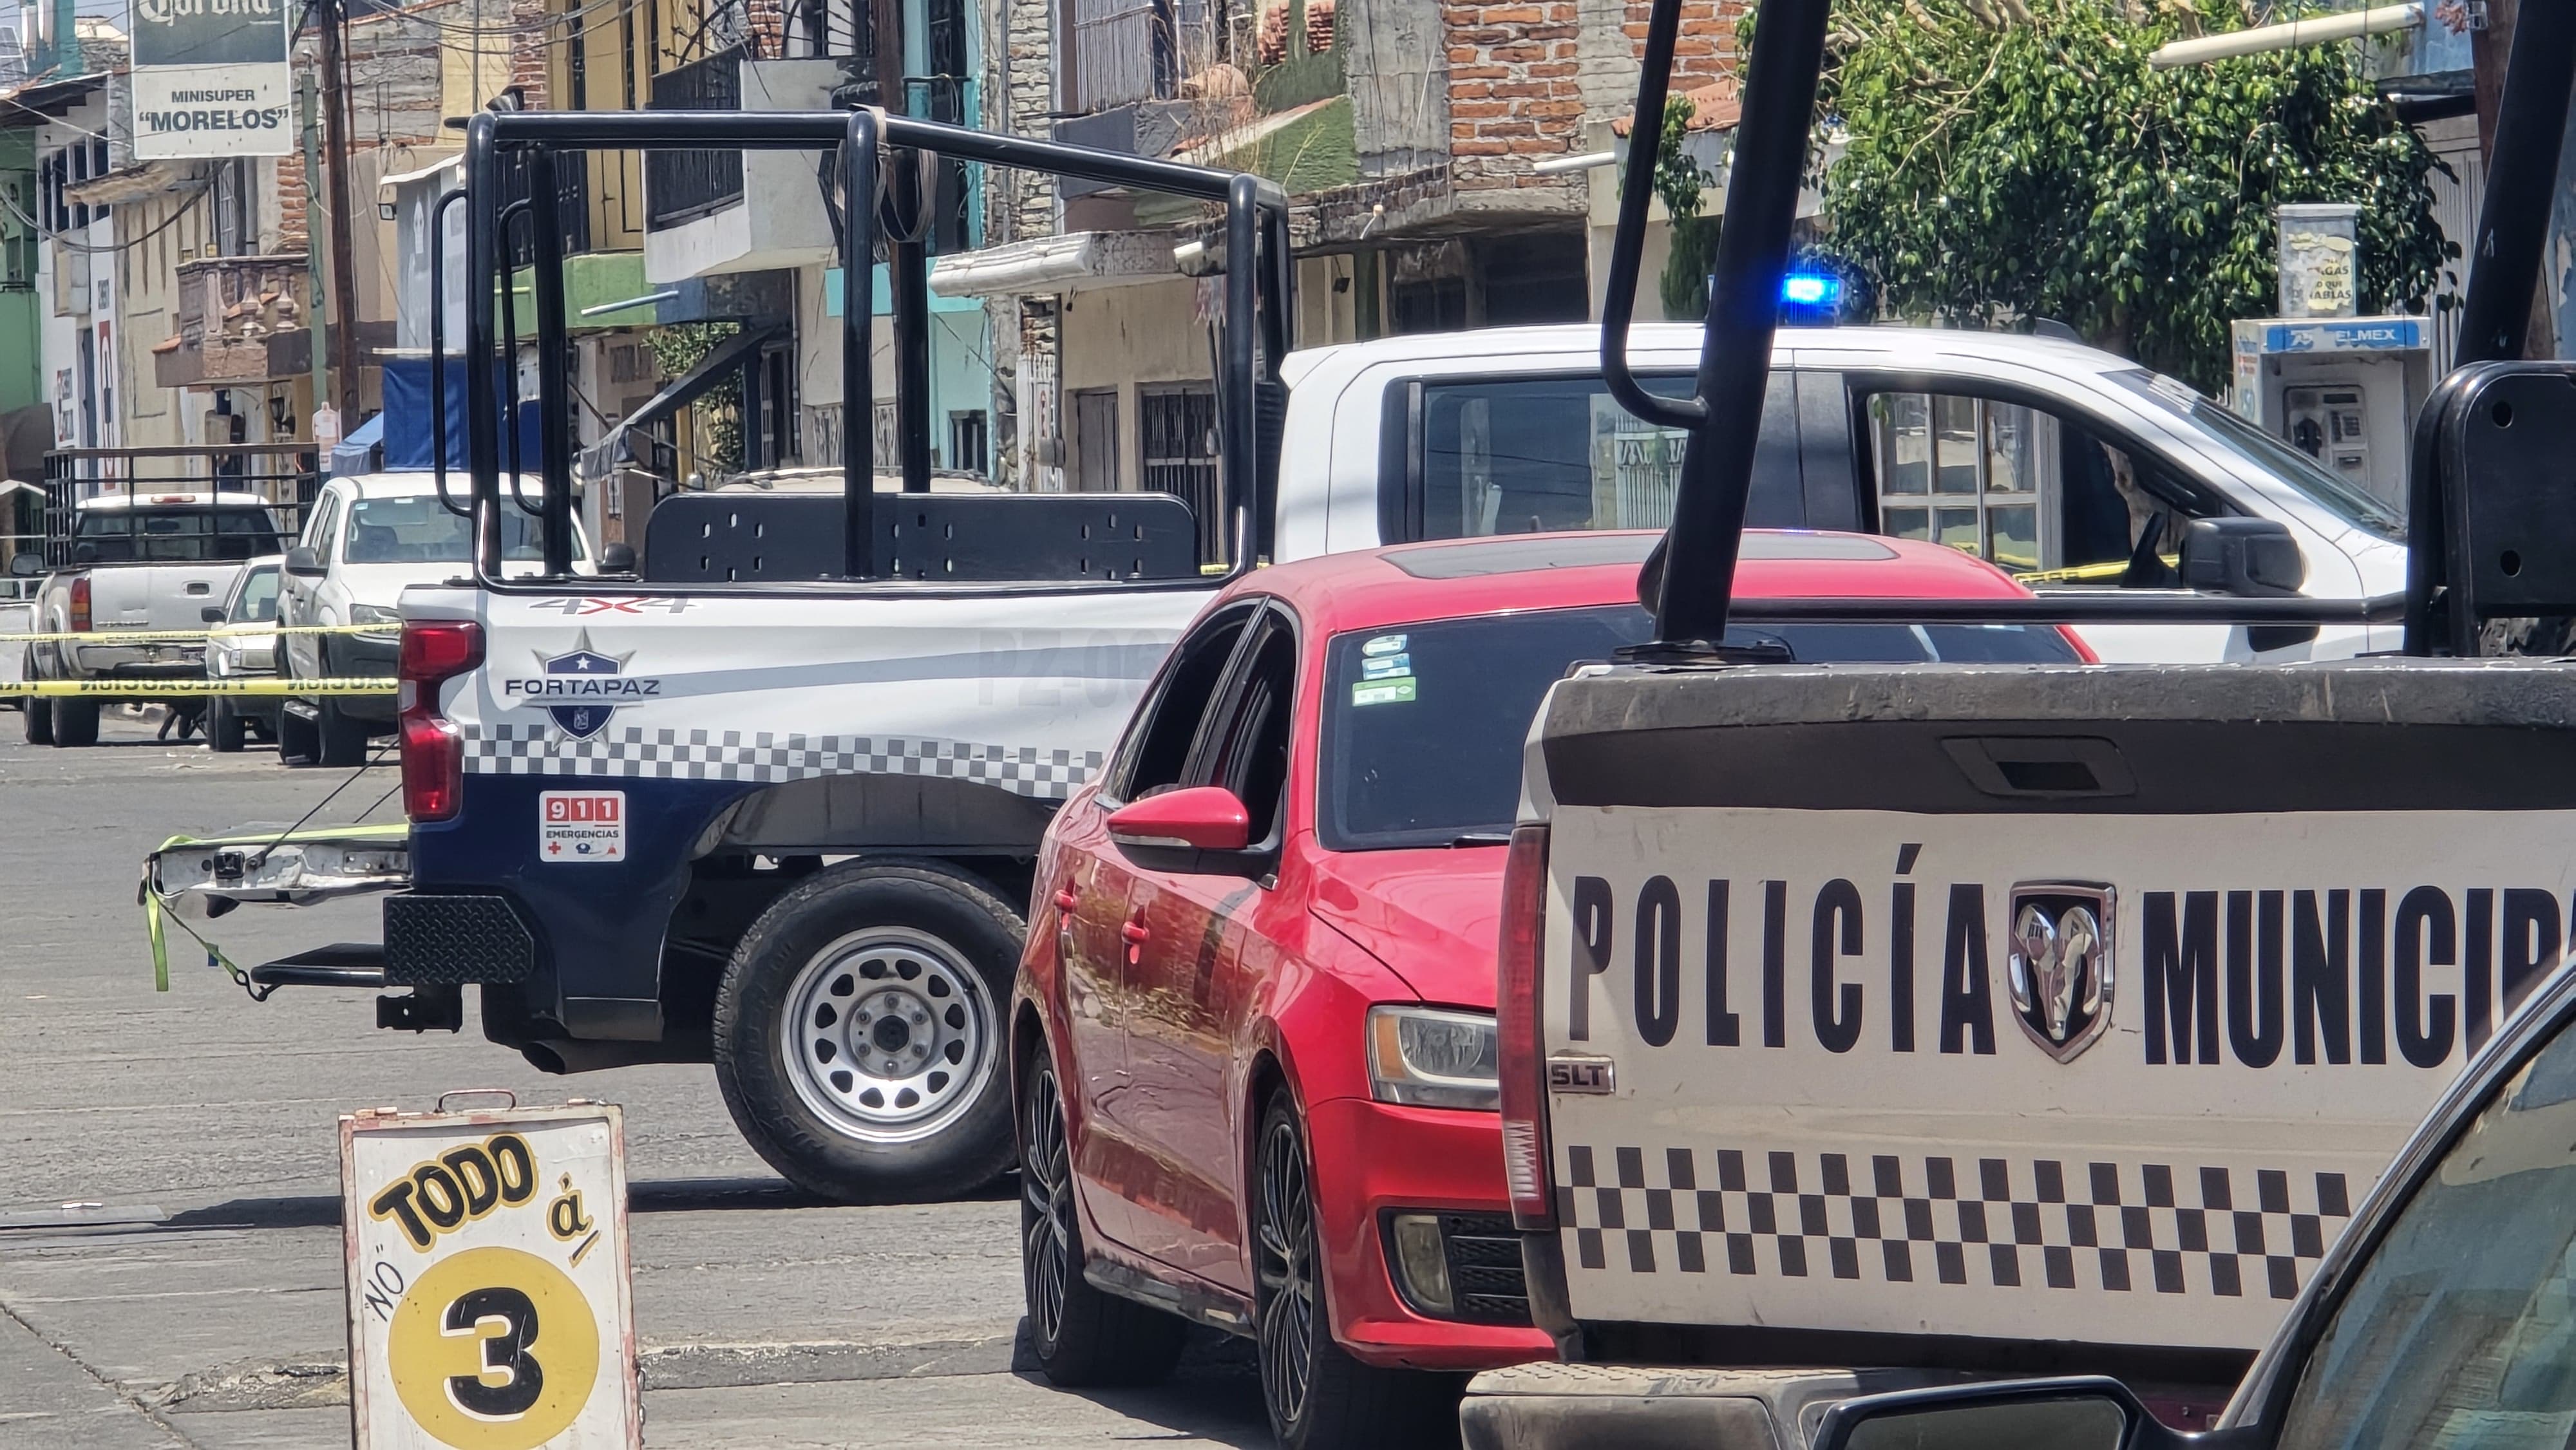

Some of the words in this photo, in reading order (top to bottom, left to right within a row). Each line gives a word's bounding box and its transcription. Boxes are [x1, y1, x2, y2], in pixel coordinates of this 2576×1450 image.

[171, 89, 255, 102] MINISUPER
[2309, 290, 2351, 299] ABLAS
[2335, 329, 2396, 342] ELMEX
[506, 679, 660, 695] FORTAPAZ
[549, 799, 613, 820] 911
[545, 830, 620, 839] EMERGENCIAS
[1569, 842, 1997, 1055] POLICÍA
[2142, 885, 2576, 1069] MUNICIP
[1551, 1064, 1604, 1086] SLT
[369, 1133, 538, 1251] TODO
[440, 1287, 544, 1422] 3
